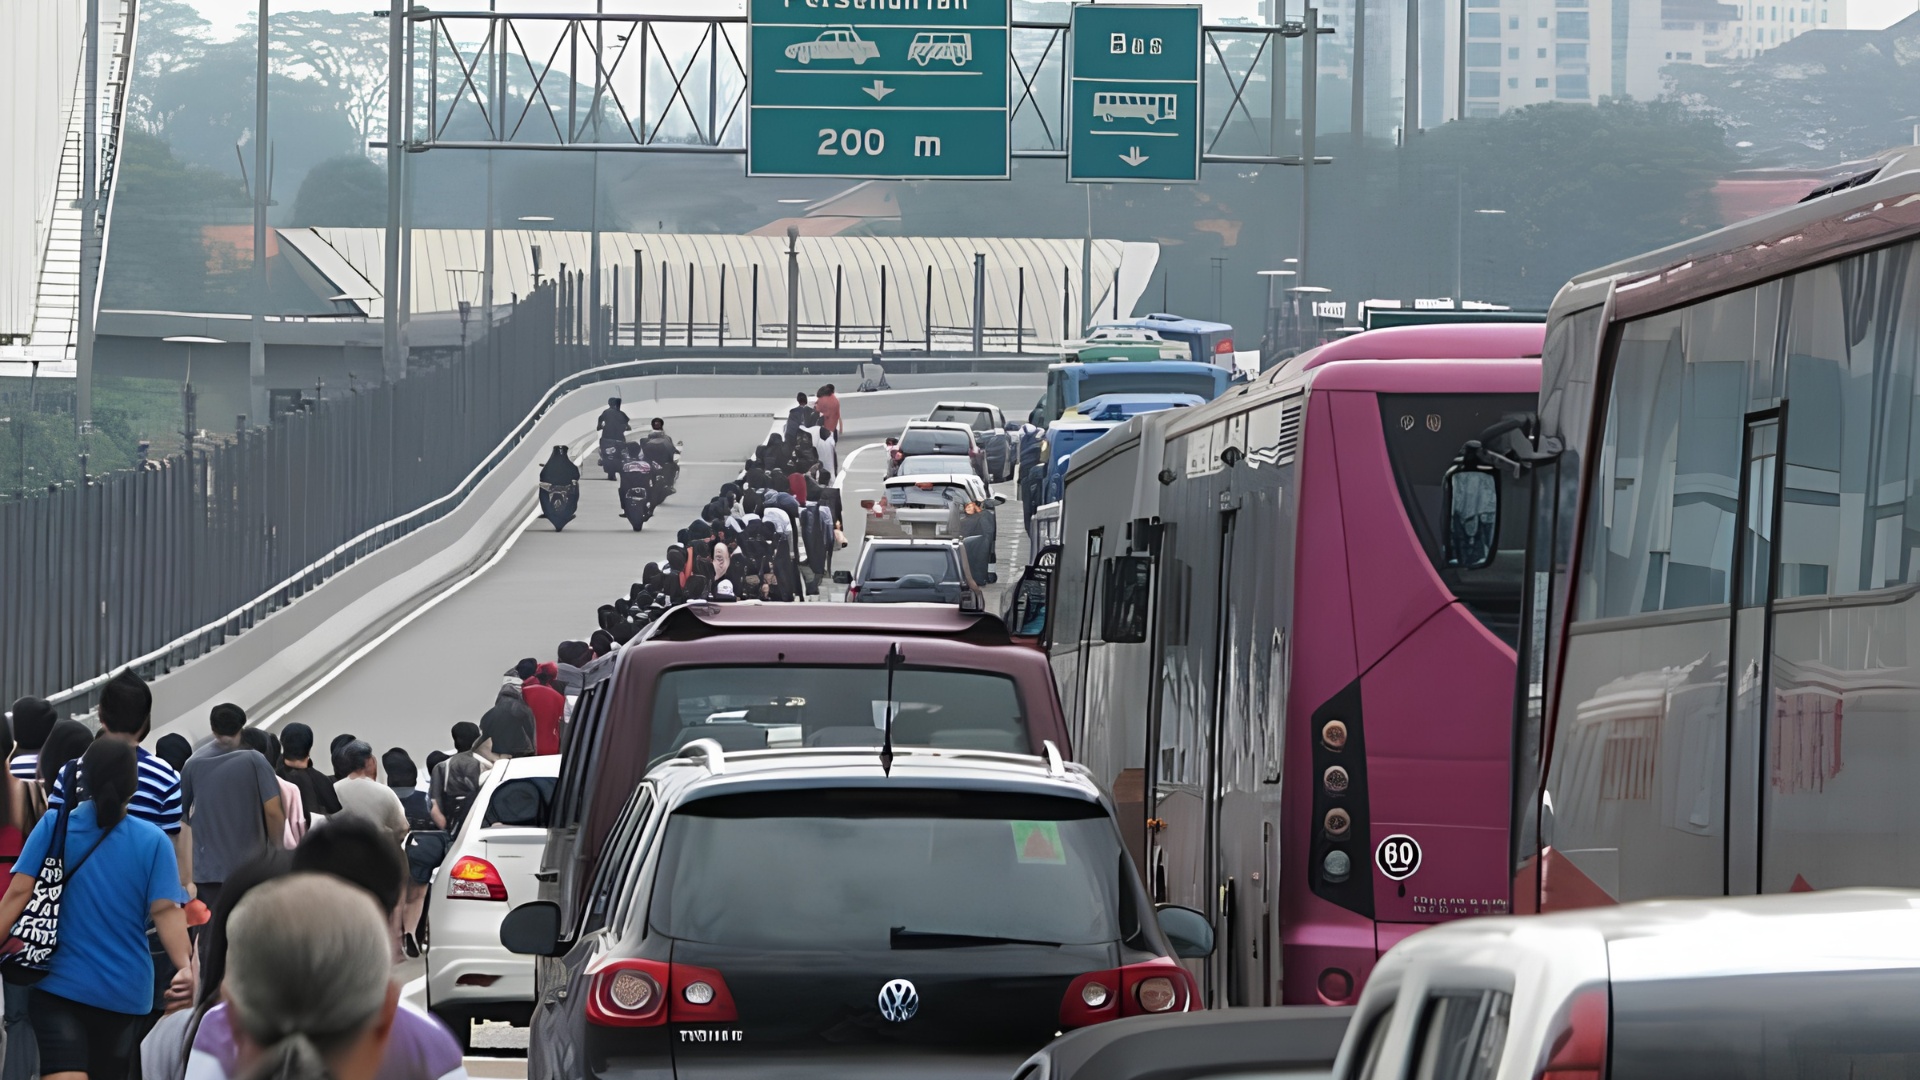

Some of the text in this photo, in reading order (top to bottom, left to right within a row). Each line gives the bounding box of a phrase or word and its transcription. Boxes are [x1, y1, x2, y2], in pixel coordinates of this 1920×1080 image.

[1110, 32, 1162, 55] Bus
[817, 128, 941, 157] 200 m
